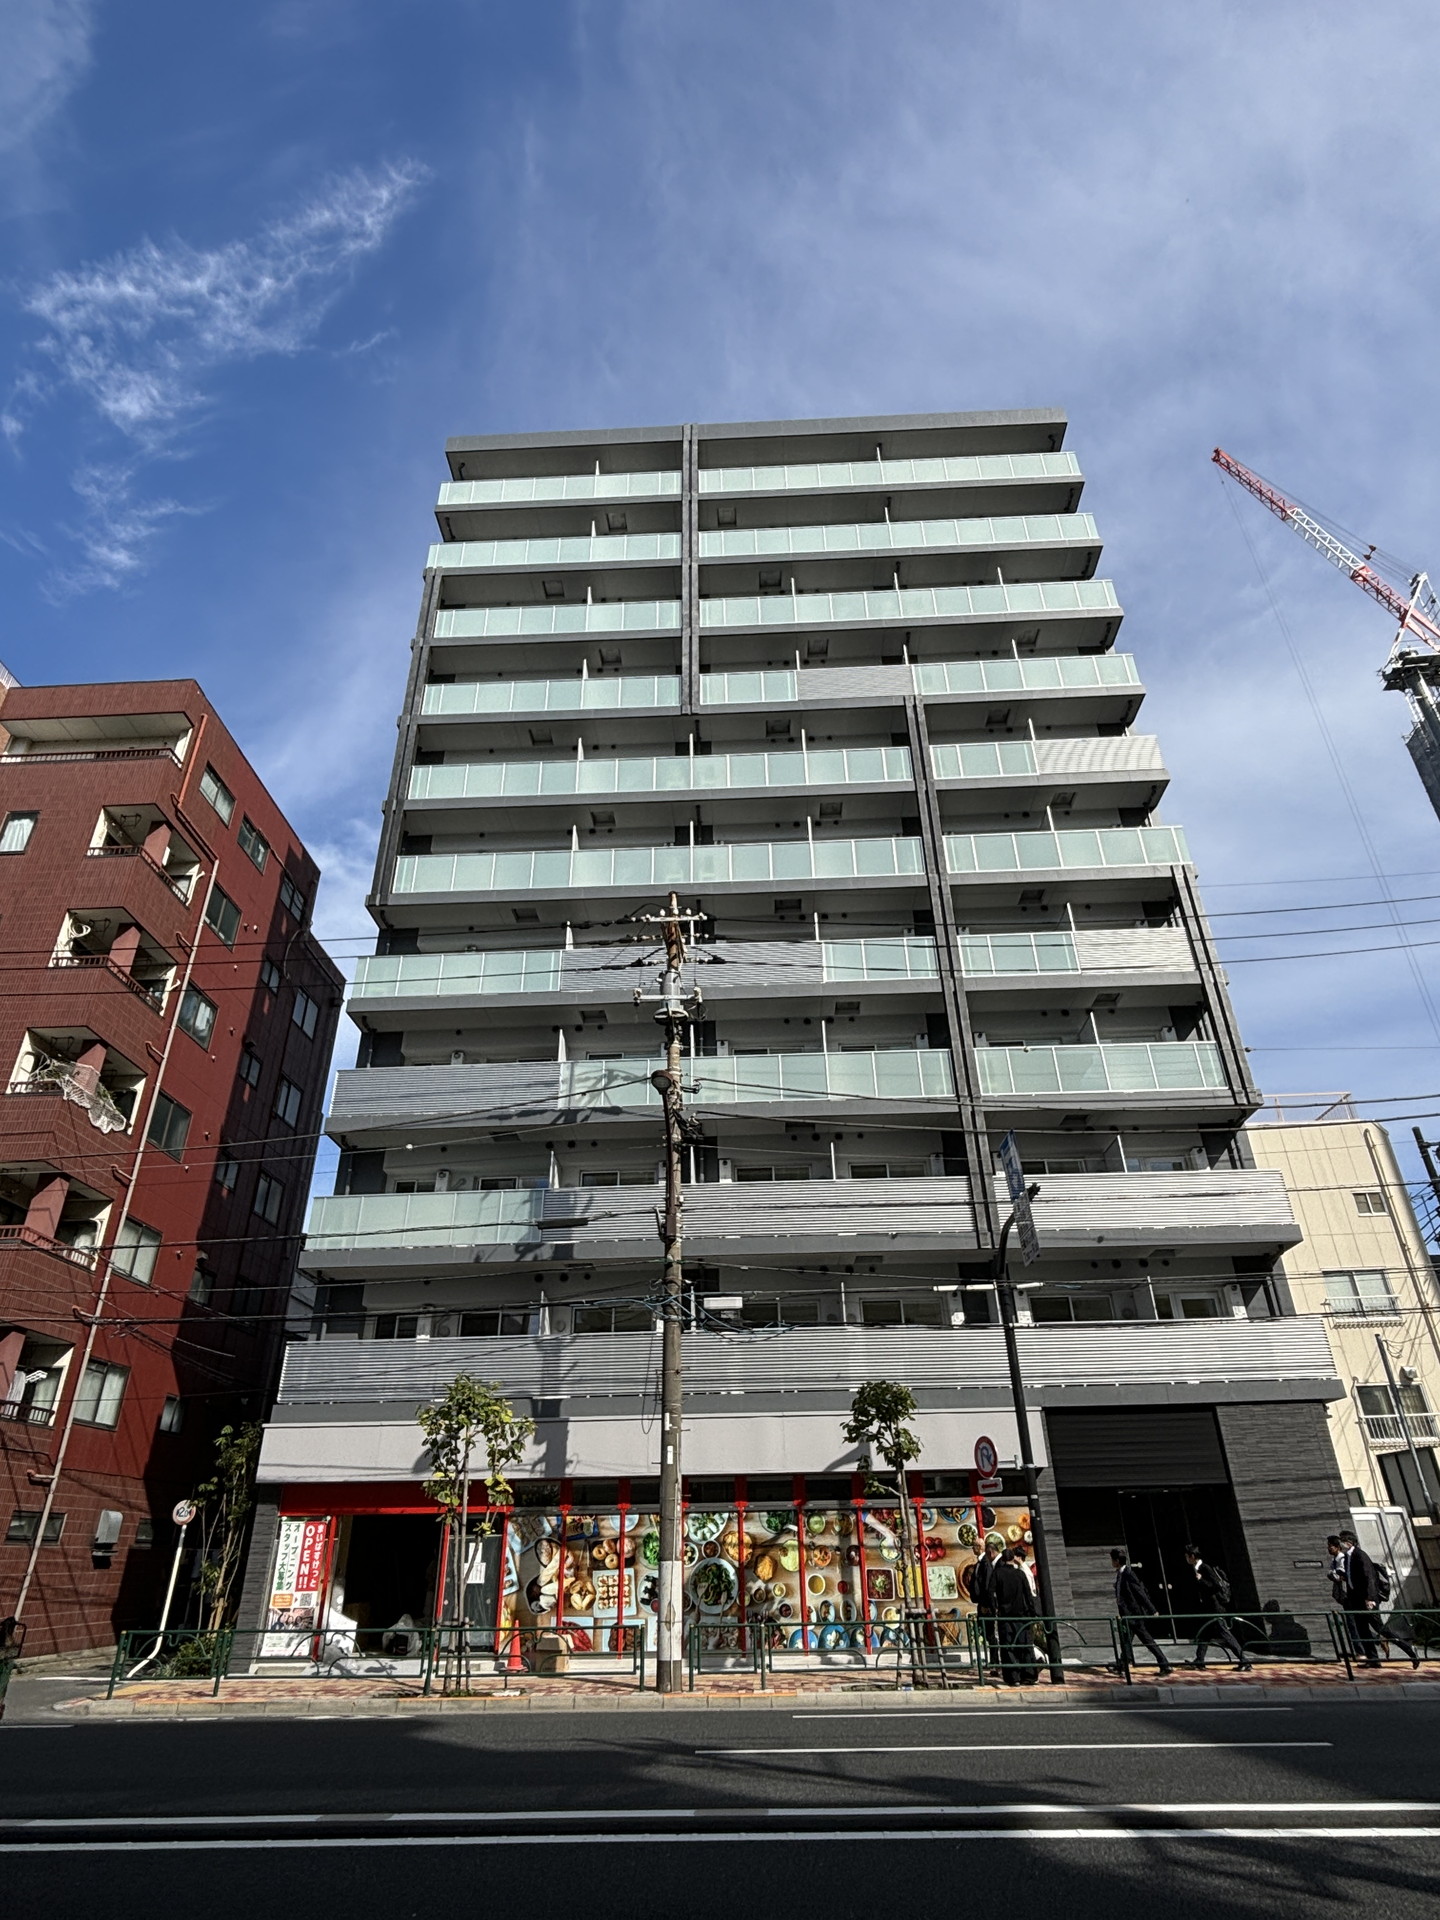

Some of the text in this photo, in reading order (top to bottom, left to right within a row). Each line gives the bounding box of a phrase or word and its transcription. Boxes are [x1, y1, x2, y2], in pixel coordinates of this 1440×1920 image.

[285, 1523, 301, 1591] オープニング
[298, 1525, 316, 1589] OPEN!!
[309, 1524, 325, 1587] まいばすけっと
